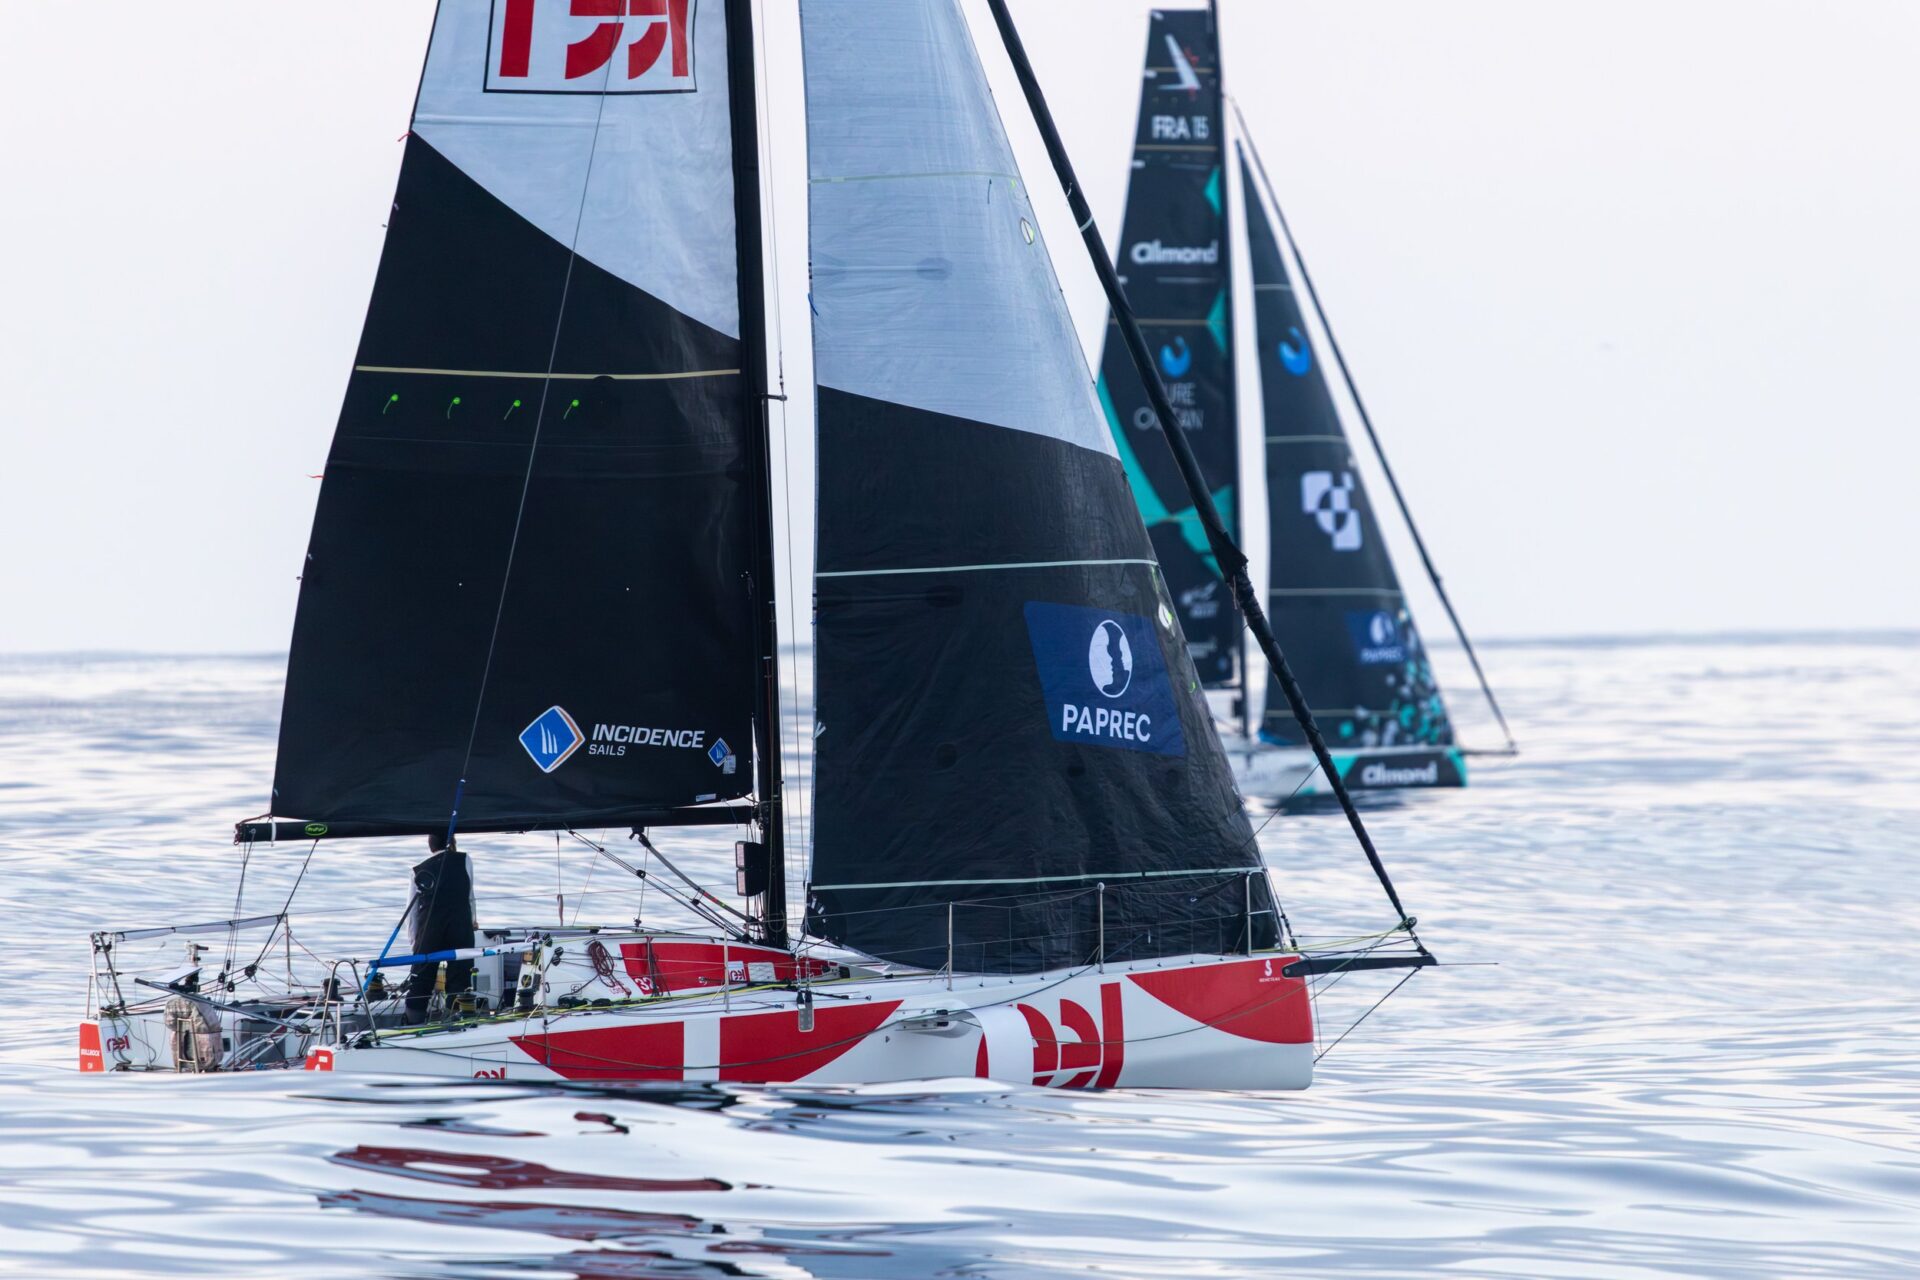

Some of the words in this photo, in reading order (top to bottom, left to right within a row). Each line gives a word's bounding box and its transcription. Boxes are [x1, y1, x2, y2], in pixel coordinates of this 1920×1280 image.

[1152, 115, 1191, 139] FRA
[1192, 115, 1209, 139] 15
[1062, 703, 1151, 743] PAPREC
[592, 723, 705, 748] INCIDENCE
[588, 744, 626, 756] SAILS
